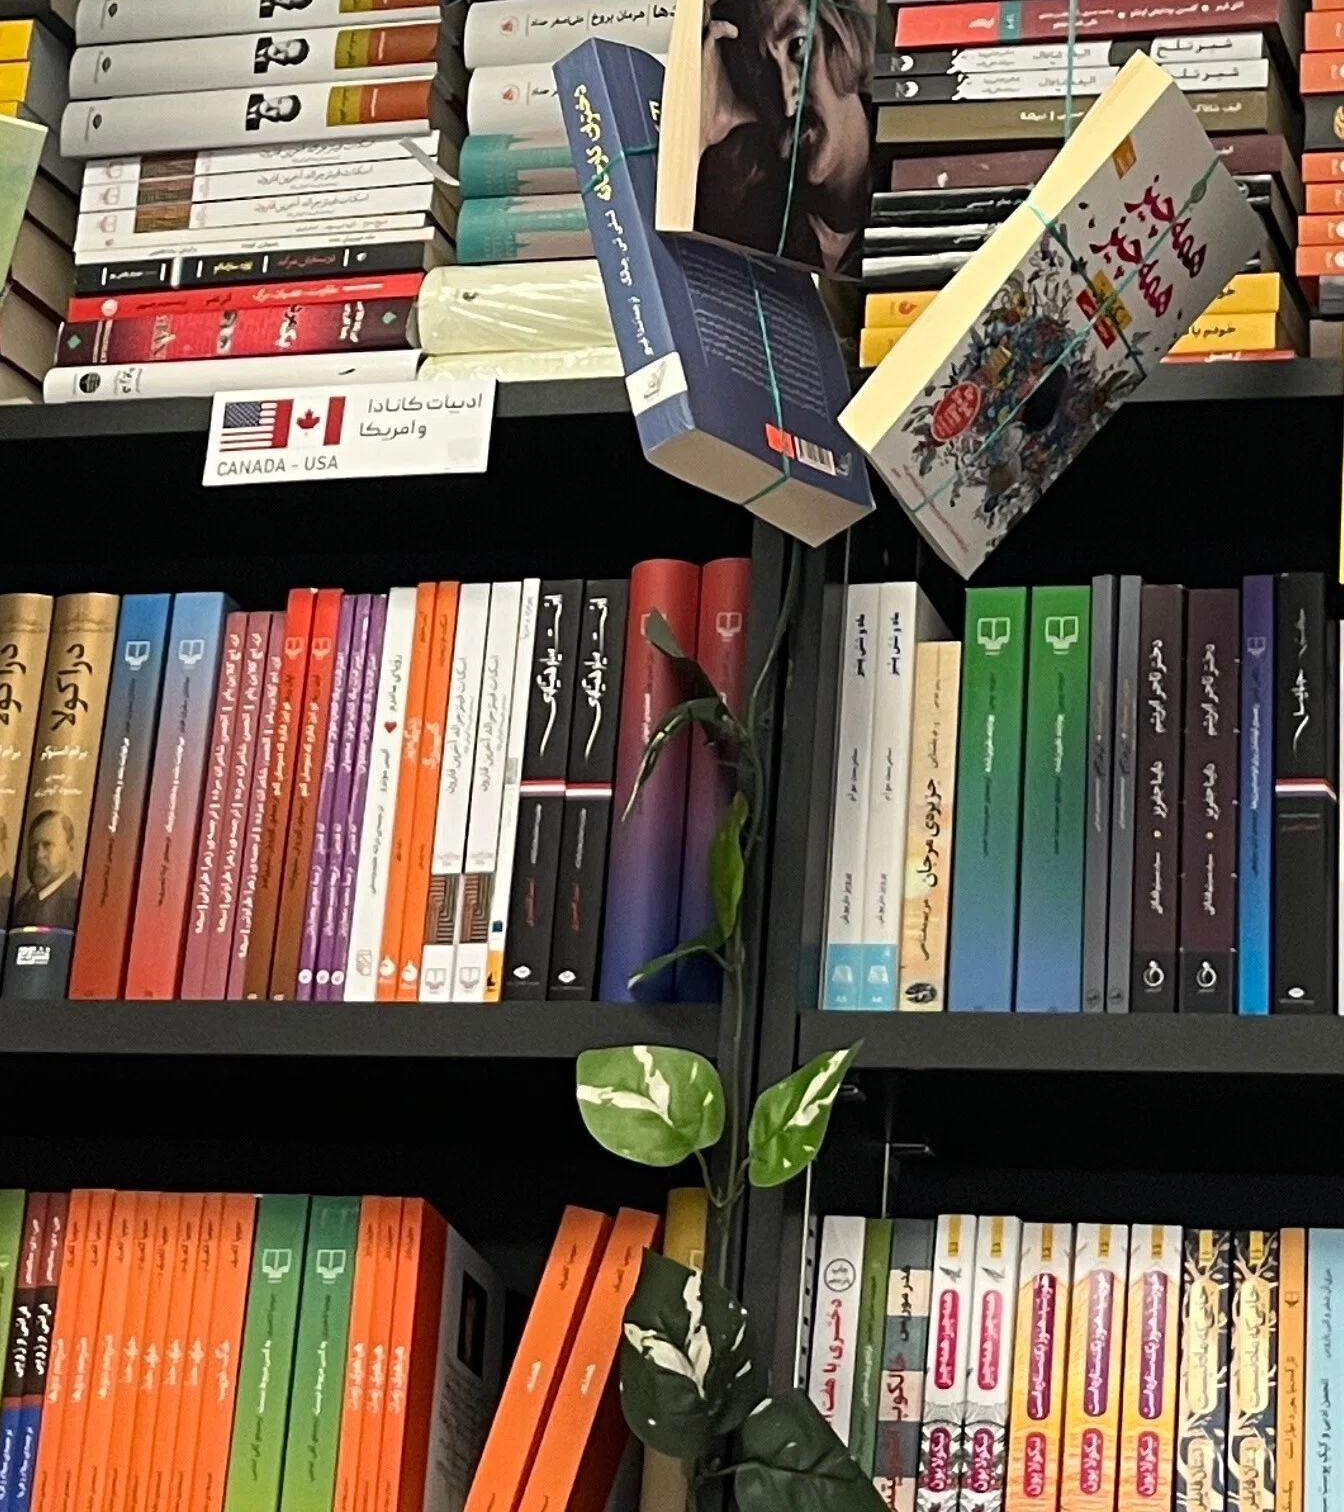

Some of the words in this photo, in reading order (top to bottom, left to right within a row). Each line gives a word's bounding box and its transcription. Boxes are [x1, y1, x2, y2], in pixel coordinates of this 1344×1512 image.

[616, 9, 646, 26] هرمان
[367, 397, 427, 415] کانادا
[426, 393, 484, 414] ادبیات
[216, 455, 287, 477] CANADA
[303, 454, 339, 471] USA
[1147, 639, 1167, 672] دختر
[1203, 643, 1218, 676] دختر
[51, 643, 93, 733] دراکولا
[916, 839, 940, 888] مرجان
[827, 1298, 846, 1360] دختری
[819, 1378, 838, 1410] هفت
[1319, 1379, 1331, 1406] انجمن
[1319, 1406, 1331, 1431] ادبی
[935, 1431, 951, 1469] نیکولا
[975, 1432, 991, 1469] نیکولا
[1027, 1437, 1043, 1473] نیکولا
[1320, 1466, 1331, 1494] پوست
